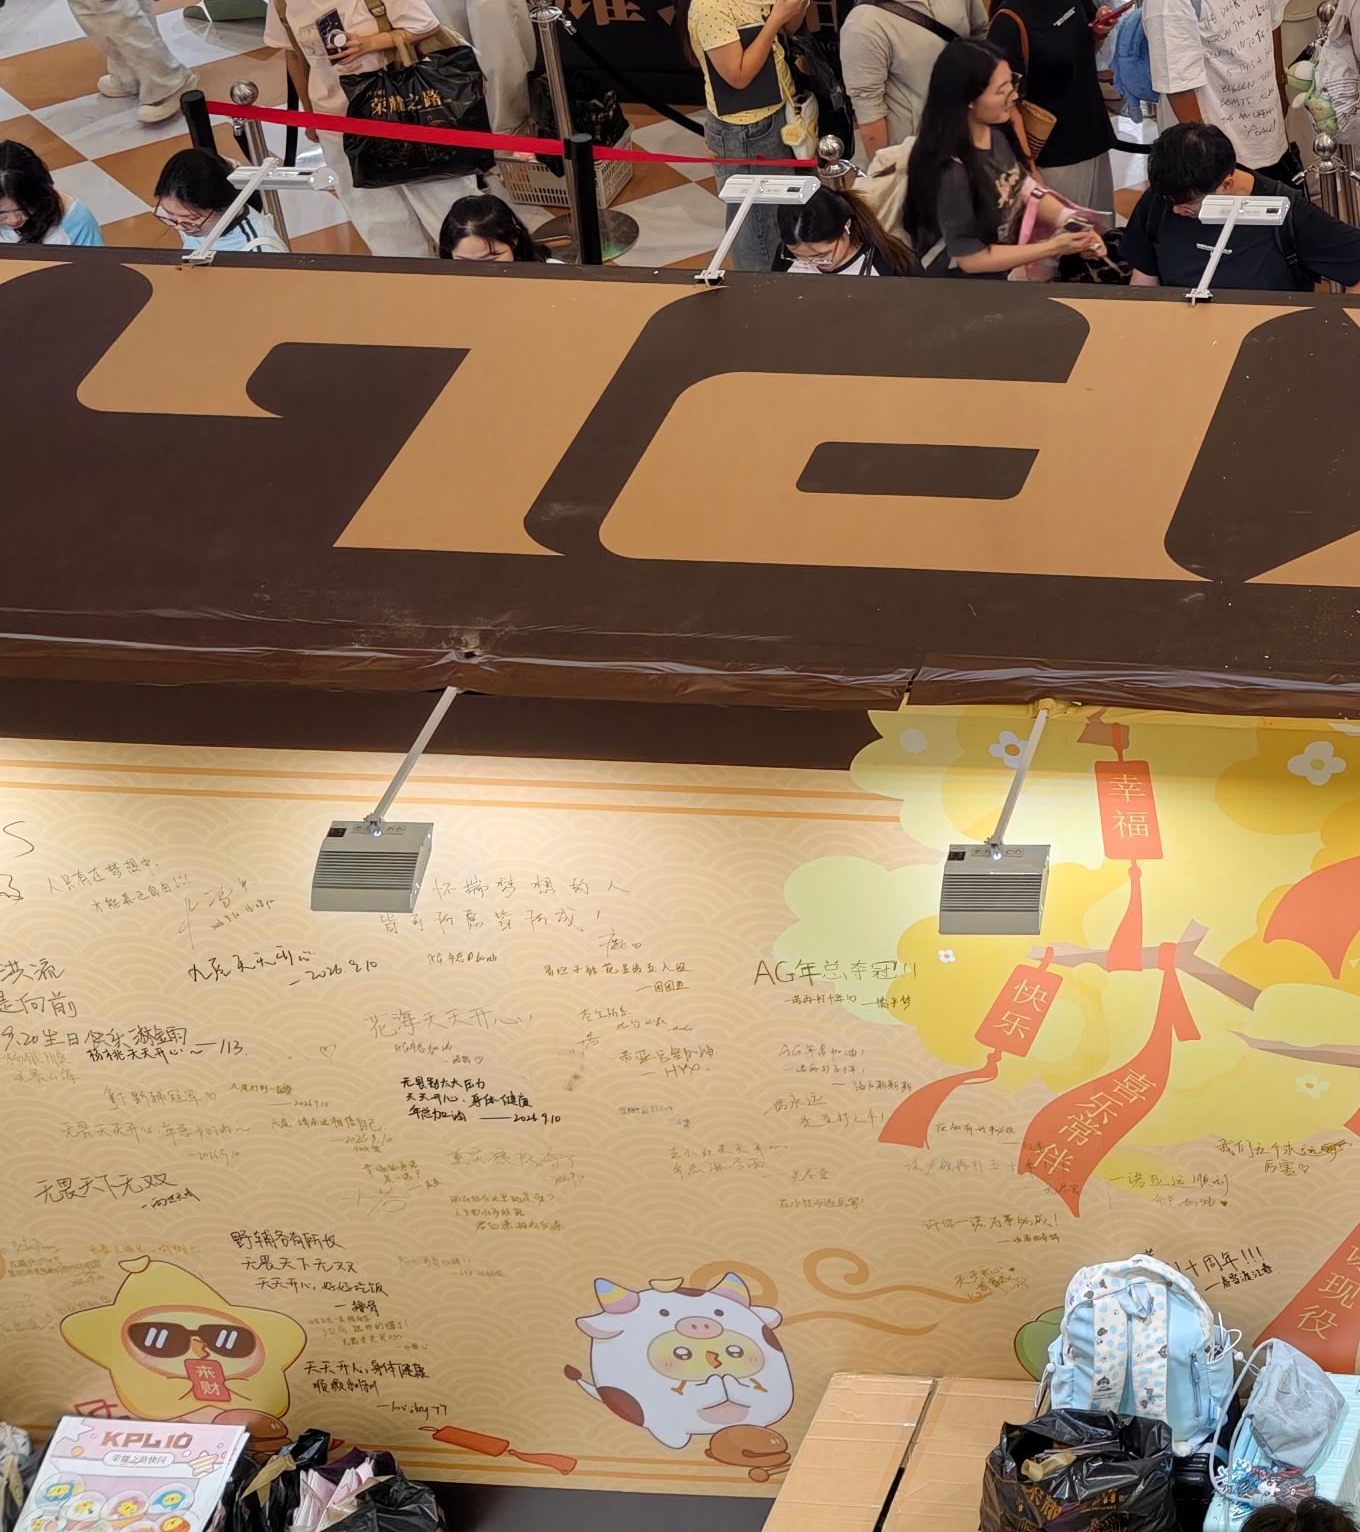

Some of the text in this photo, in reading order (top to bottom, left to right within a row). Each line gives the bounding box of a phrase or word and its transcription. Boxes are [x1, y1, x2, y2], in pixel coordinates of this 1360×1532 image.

[1107, 773, 1151, 840] 幸福
[995, 977, 1048, 1039] 快乐
[1033, 1066, 1158, 1177] 喜乐常伴
[101, 1431, 193, 1449] KPL10
